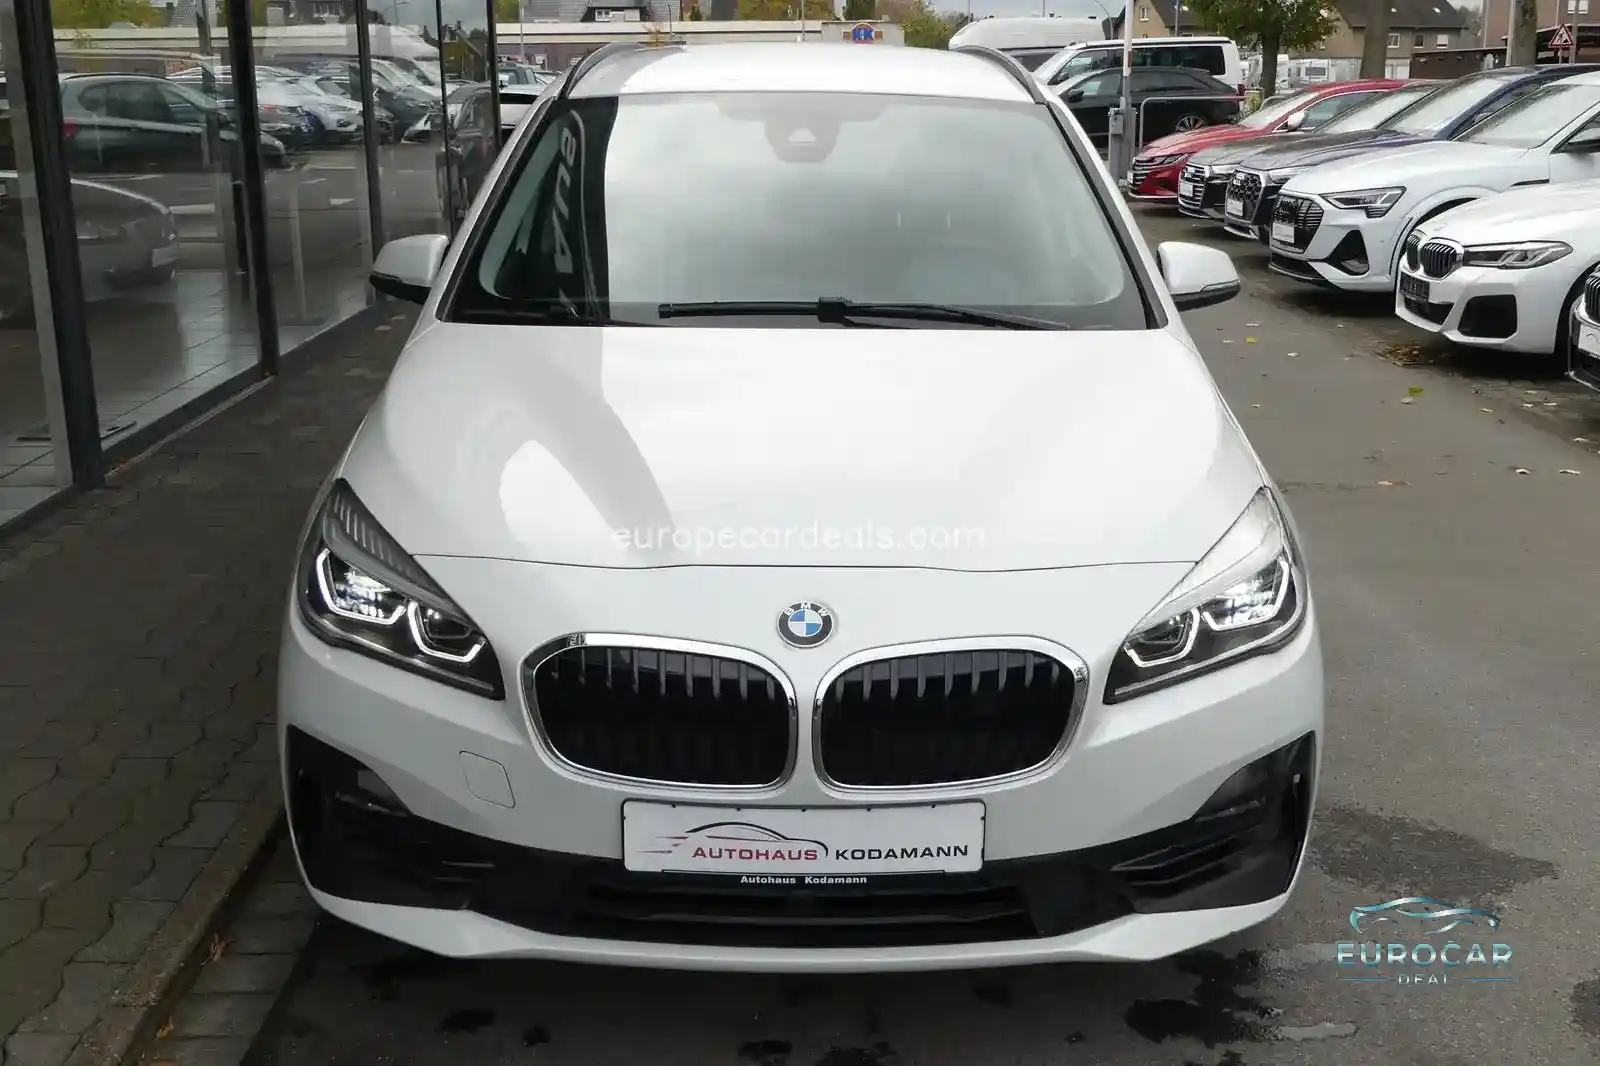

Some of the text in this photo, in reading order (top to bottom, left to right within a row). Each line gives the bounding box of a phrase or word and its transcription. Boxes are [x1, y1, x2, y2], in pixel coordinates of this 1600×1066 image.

[692, 845, 968, 861] AUTOHAUS KODAMANN
[740, 875, 868, 885] Autohaus Kodamann
